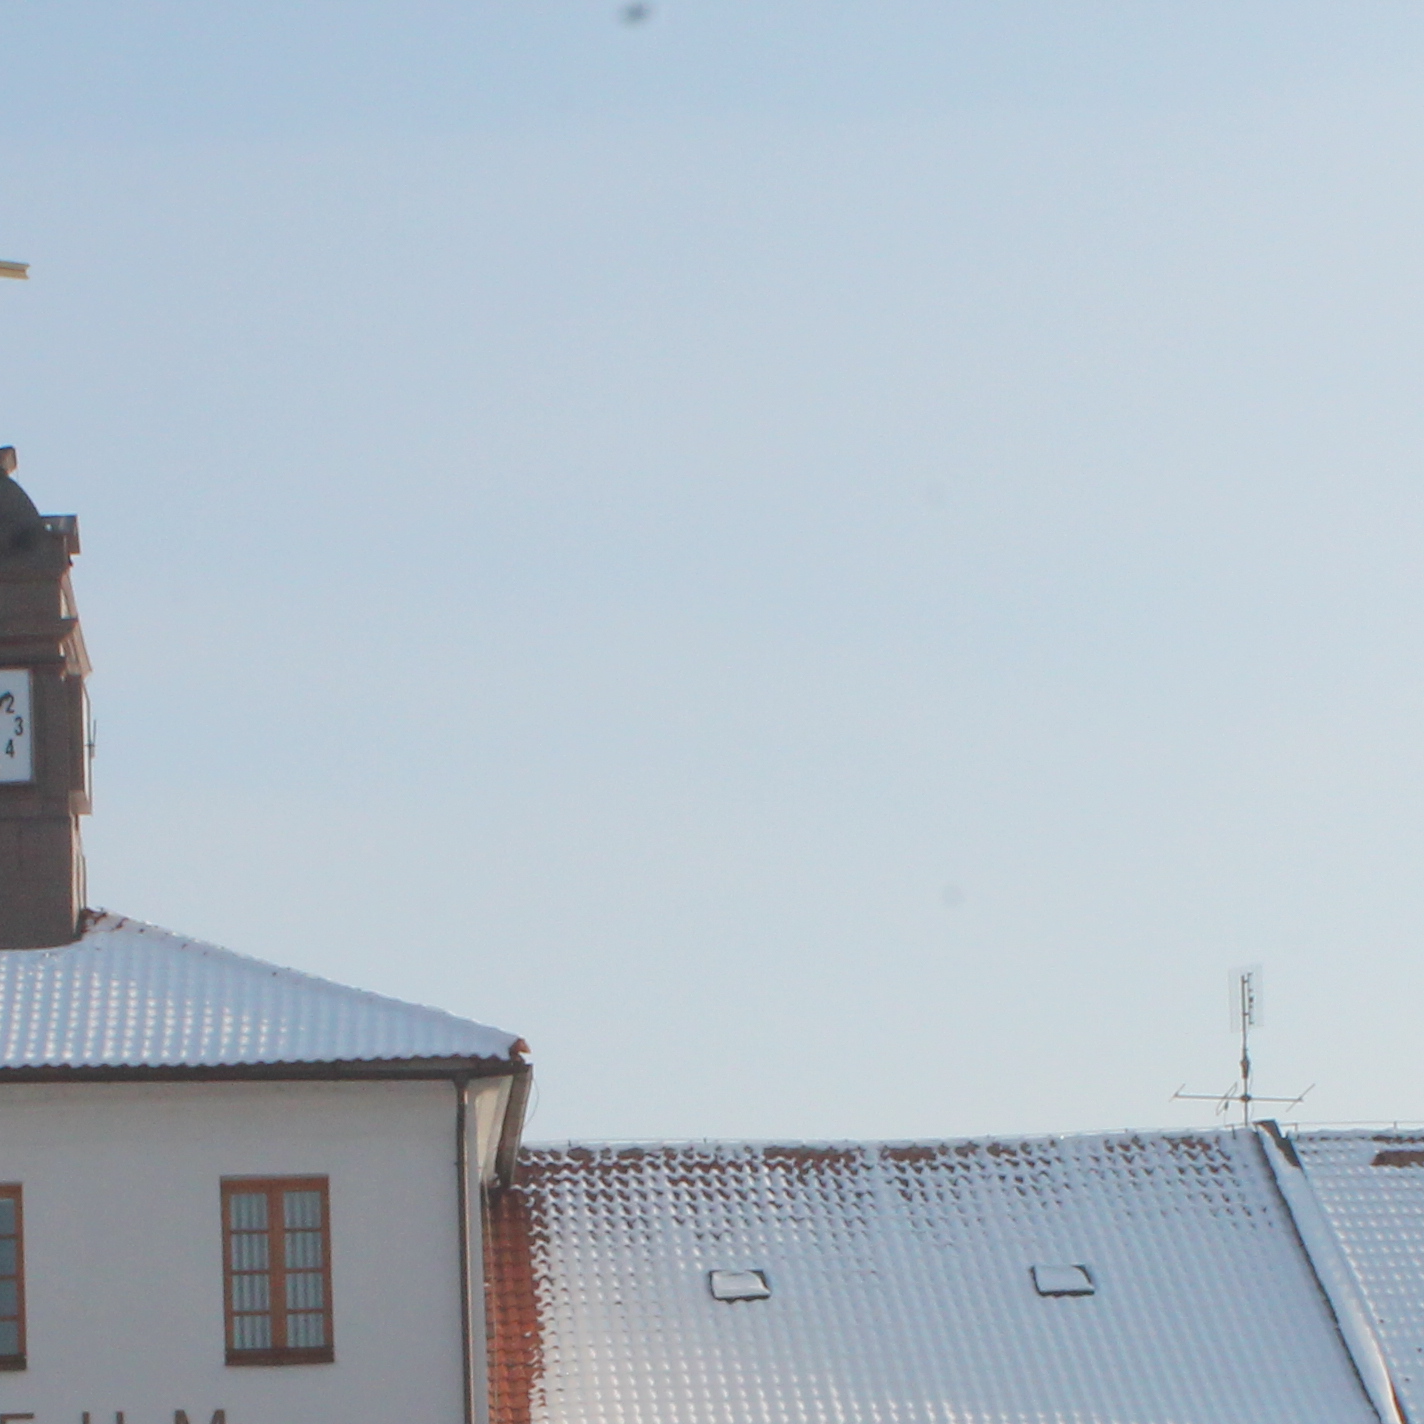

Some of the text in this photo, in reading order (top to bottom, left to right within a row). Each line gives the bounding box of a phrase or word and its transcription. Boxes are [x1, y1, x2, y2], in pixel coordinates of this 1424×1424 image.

[5, 695, 15, 713] 2
[14, 717, 23, 736] 3
[5, 739, 15, 758] 4
